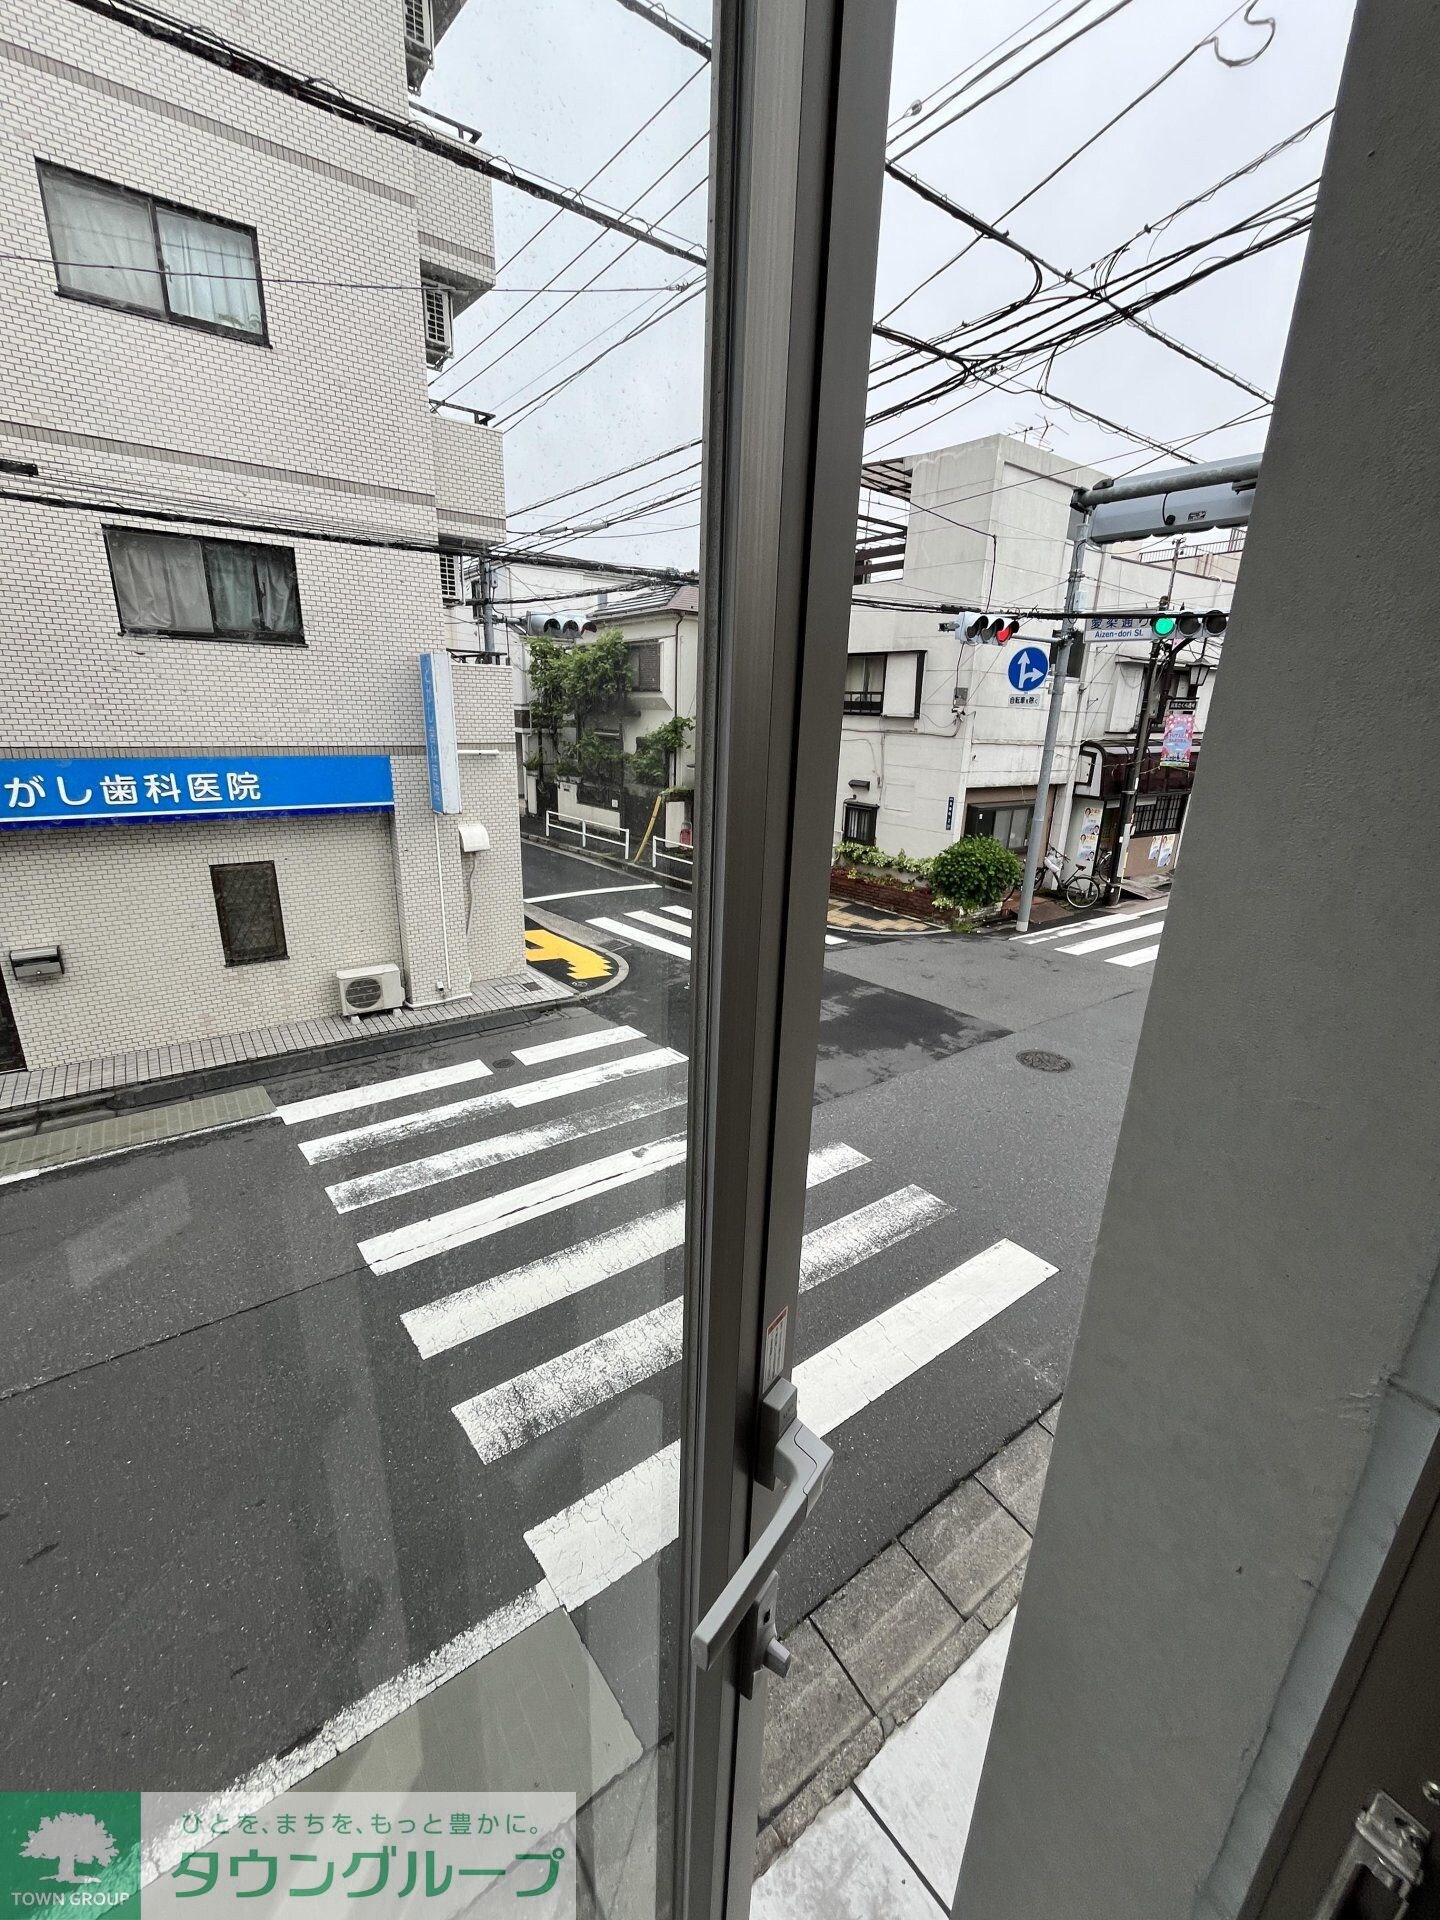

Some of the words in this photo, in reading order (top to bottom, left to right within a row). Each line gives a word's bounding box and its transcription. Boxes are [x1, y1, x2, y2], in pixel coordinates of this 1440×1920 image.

[1095, 630, 1132, 638] Aizen-dori
[4, 771, 262, 809] がし歯科医院
